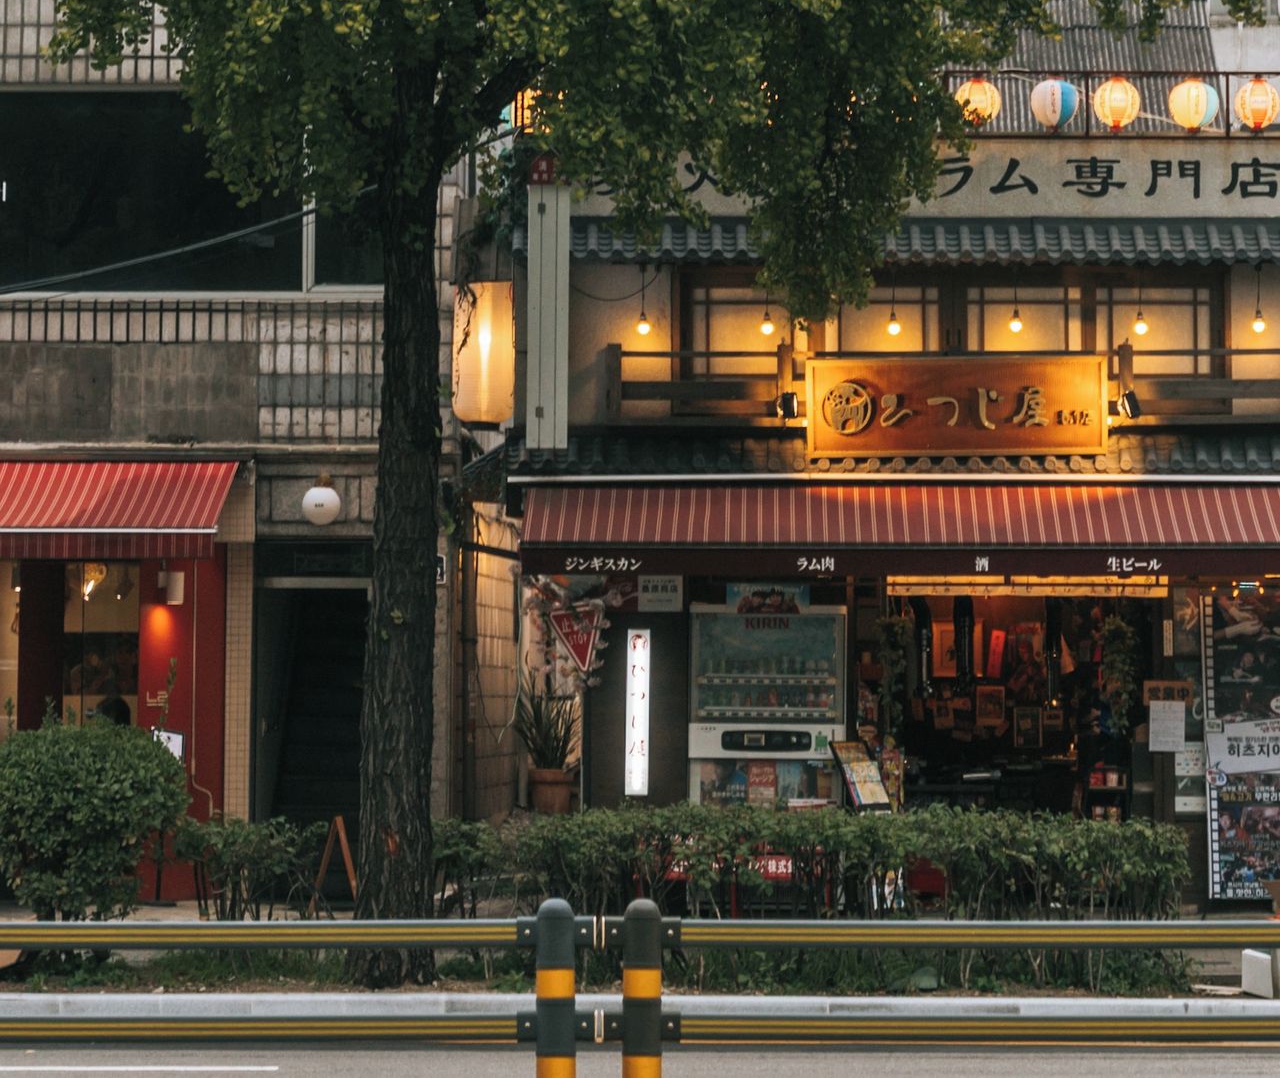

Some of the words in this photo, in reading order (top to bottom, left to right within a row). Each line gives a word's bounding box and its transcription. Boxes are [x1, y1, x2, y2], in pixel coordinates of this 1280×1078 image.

[565, 556, 643, 572] ジンギスカン
[797, 556, 835, 572] ラム肉
[974, 556, 990, 572] 酒
[1106, 556, 1162, 572] 生ビール
[745, 617, 789, 629] KIRIN
